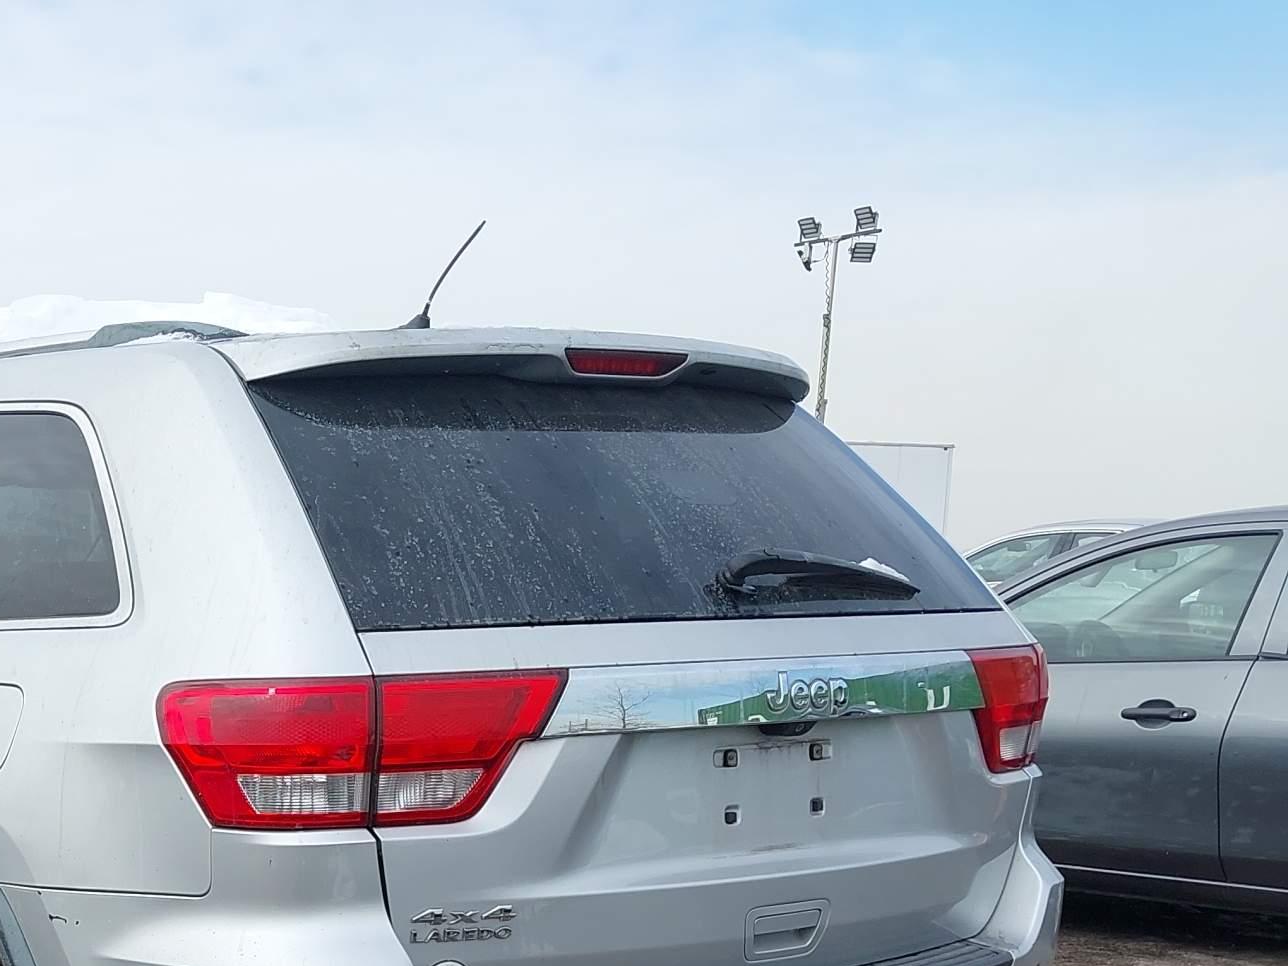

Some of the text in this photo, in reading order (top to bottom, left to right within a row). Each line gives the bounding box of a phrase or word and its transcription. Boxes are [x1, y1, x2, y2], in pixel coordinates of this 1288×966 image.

[765, 670, 849, 716] Jeep
[409, 904, 518, 926] 4x4
[409, 926, 513, 944] LAREDO
